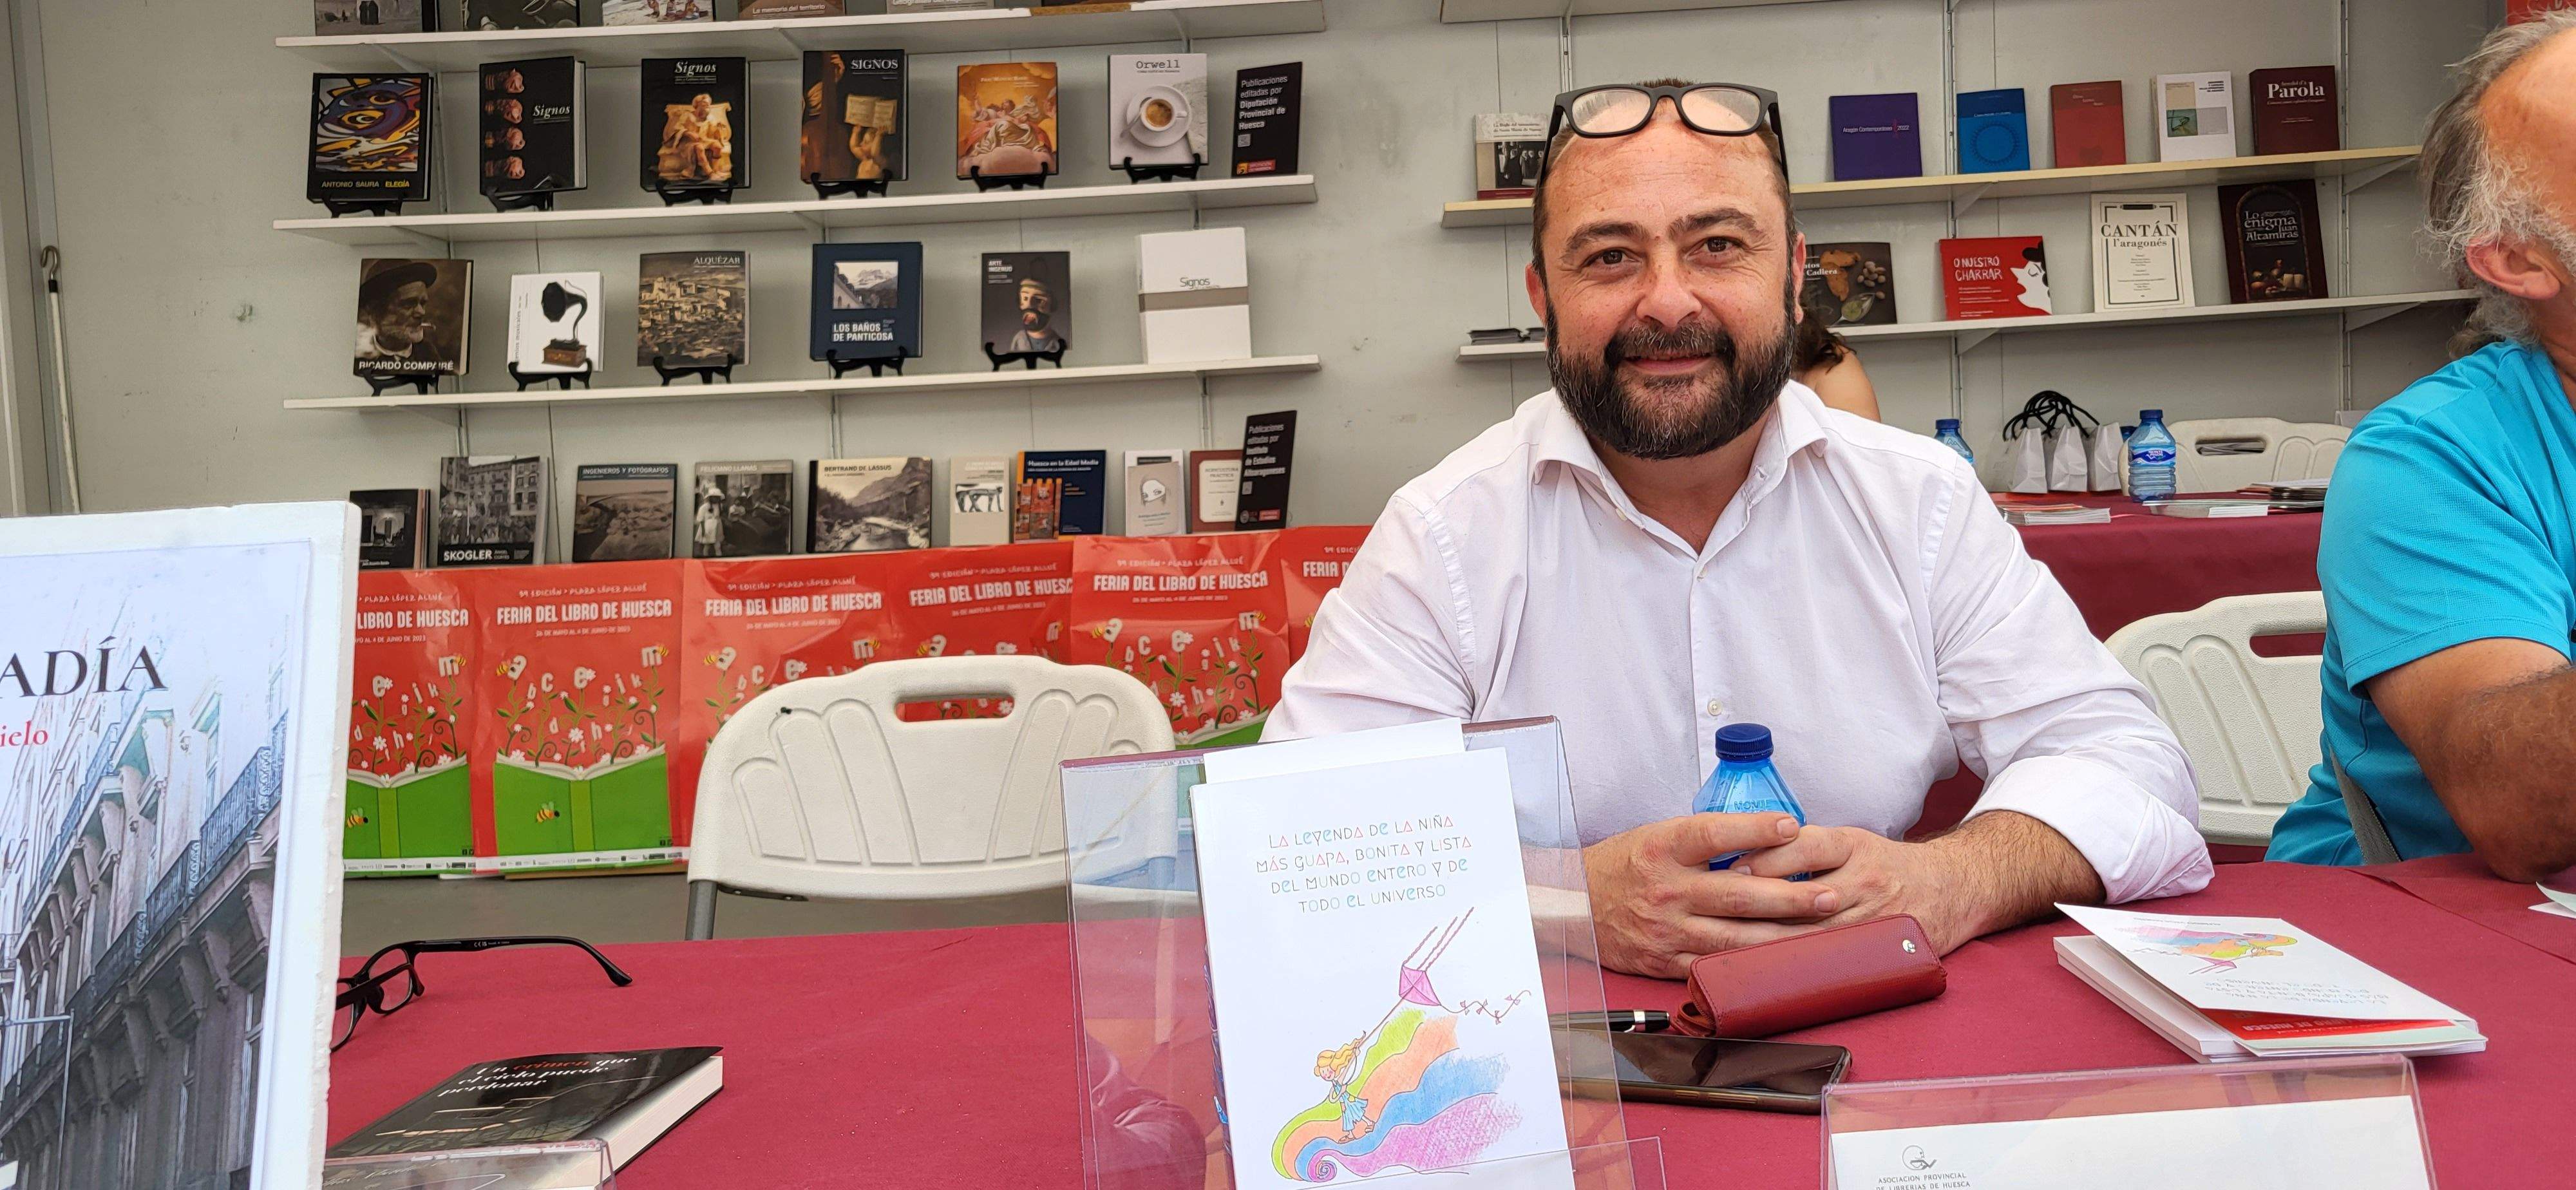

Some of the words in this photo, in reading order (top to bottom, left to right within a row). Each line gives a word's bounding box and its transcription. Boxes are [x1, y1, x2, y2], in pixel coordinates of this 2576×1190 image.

[675, 62, 716, 76] Signos
[851, 59, 898, 70] SIGNOS
[1136, 60, 1180, 69] Orwell
[1242, 76, 1287, 88] Publicaciones
[1240, 89, 1269, 98] editadas
[1270, 87, 1282, 97] por
[2268, 81, 2325, 99] Parola
[1240, 98, 1278, 109] Diputación
[533, 104, 570, 118] Signos
[1239, 108, 1274, 119] Provincial
[1238, 121, 1265, 130] Huesca
[385, 179, 410, 187] ELEGÍA
[2245, 211, 2259, 219] Lo
[2101, 220, 2178, 238] CANTÁN
[2244, 216, 2297, 231] enigma
[2278, 225, 2298, 233] Juan
[2246, 231, 2298, 241] Altamiras
[694, 256, 740, 265] ALQUÉZAR
[1954, 258, 1959, 268] O
[1962, 256, 2000, 268] NUESTRO
[1955, 269, 2002, 281] CHARRAR
[1180, 277, 1210, 289] Signos
[833, 323, 850, 332] LOS
[852, 321, 881, 332] BAÑOS
[833, 333, 844, 342] DE
[847, 332, 893, 342] PANTICOSA
[444, 549, 492, 562] SKOGLER
[1303, 561, 1339, 577] FERIA
[1094, 574, 1129, 591] FERIA
[1133, 575, 1155, 591] DEL
[1159, 575, 1197, 591] LIBRO
[1199, 574, 1216, 590] DE
[1219, 570, 1268, 590] HUESCA
[392, 594, 415, 602] LÓPEZ
[910, 587, 946, 607] FERIA
[949, 585, 972, 603] DEL
[974, 581, 1012, 600] LIBRO
[1014, 580, 1032, 596] DE
[1034, 578, 1073, 595] HUESC
[705, 599, 742, 616] FERIA
[746, 598, 769, 616] DEL
[772, 596, 808, 614] LIBRO
[812, 595, 828, 612] DE
[831, 592, 881, 611] HUESCA
[497, 606, 532, 625] FERIA
[536, 605, 558, 623] DEL
[562, 603, 598, 622] LIBRO
[602, 601, 618, 619] DE
[621, 599, 672, 618] HUESCA
[357, 612, 393, 630] LIBRO
[397, 610, 413, 628] DE
[417, 609, 469, 628] HUESCA
[0, 636, 169, 698] ADÍA
[1269, 834, 1289, 849] LA
[1395, 820, 1413, 834] LA
[1419, 815, 1454, 831] NIÑA
[1256, 856, 1288, 873] MÁS
[1294, 851, 1349, 871] GUAPA,
[1356, 844, 1410, 861] BONITA
[1415, 841, 1425, 857] Y
[1431, 835, 1472, 852] LISTA
[1306, 872, 1361, 890] MUNDO
[1432, 862, 1441, 878] Y
[1298, 897, 1340, 913] TODO
[2242, 1021, 2293, 1031] HUESCA
[513, 1061, 589, 1070] crimen
[596, 1057, 636, 1066] que
[459, 1076, 482, 1084] el
[484, 1071, 535, 1081] cielo
[538, 1066, 609, 1079] puede
[437, 1079, 547, 1097] perdonar
[1879, 1175, 1920, 1184] ASOCIACION
[1924, 1173, 1966, 1181] PROVINCIAL
